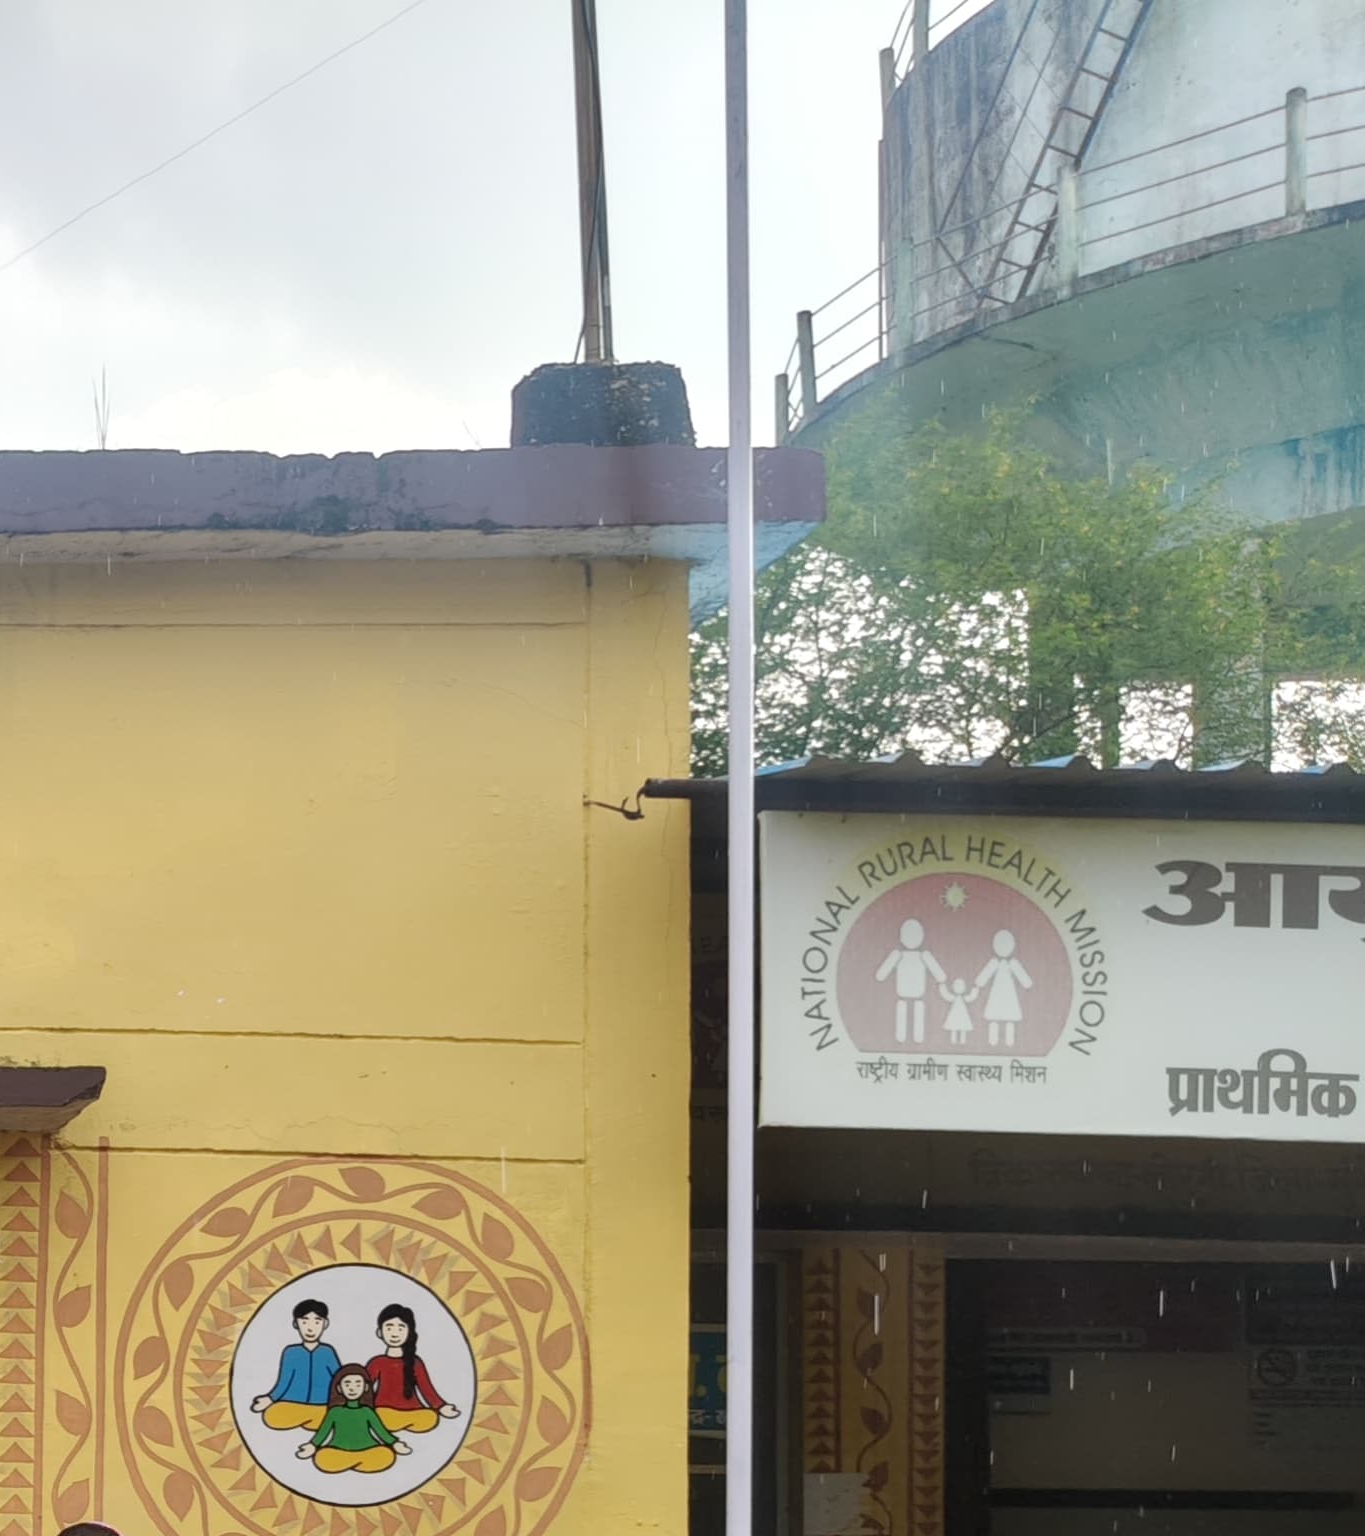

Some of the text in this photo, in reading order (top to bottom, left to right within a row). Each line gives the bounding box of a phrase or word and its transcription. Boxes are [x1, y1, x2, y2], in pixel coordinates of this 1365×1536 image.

[800, 834, 1109, 1057] NATIONAL RURAL HEALTH MISSION
[856, 1056, 1047, 1083] राष्ट्रीय ग्रामीण स्वास्थ्य मिशन
[1166, 1048, 1360, 1117] प्राथमिक
